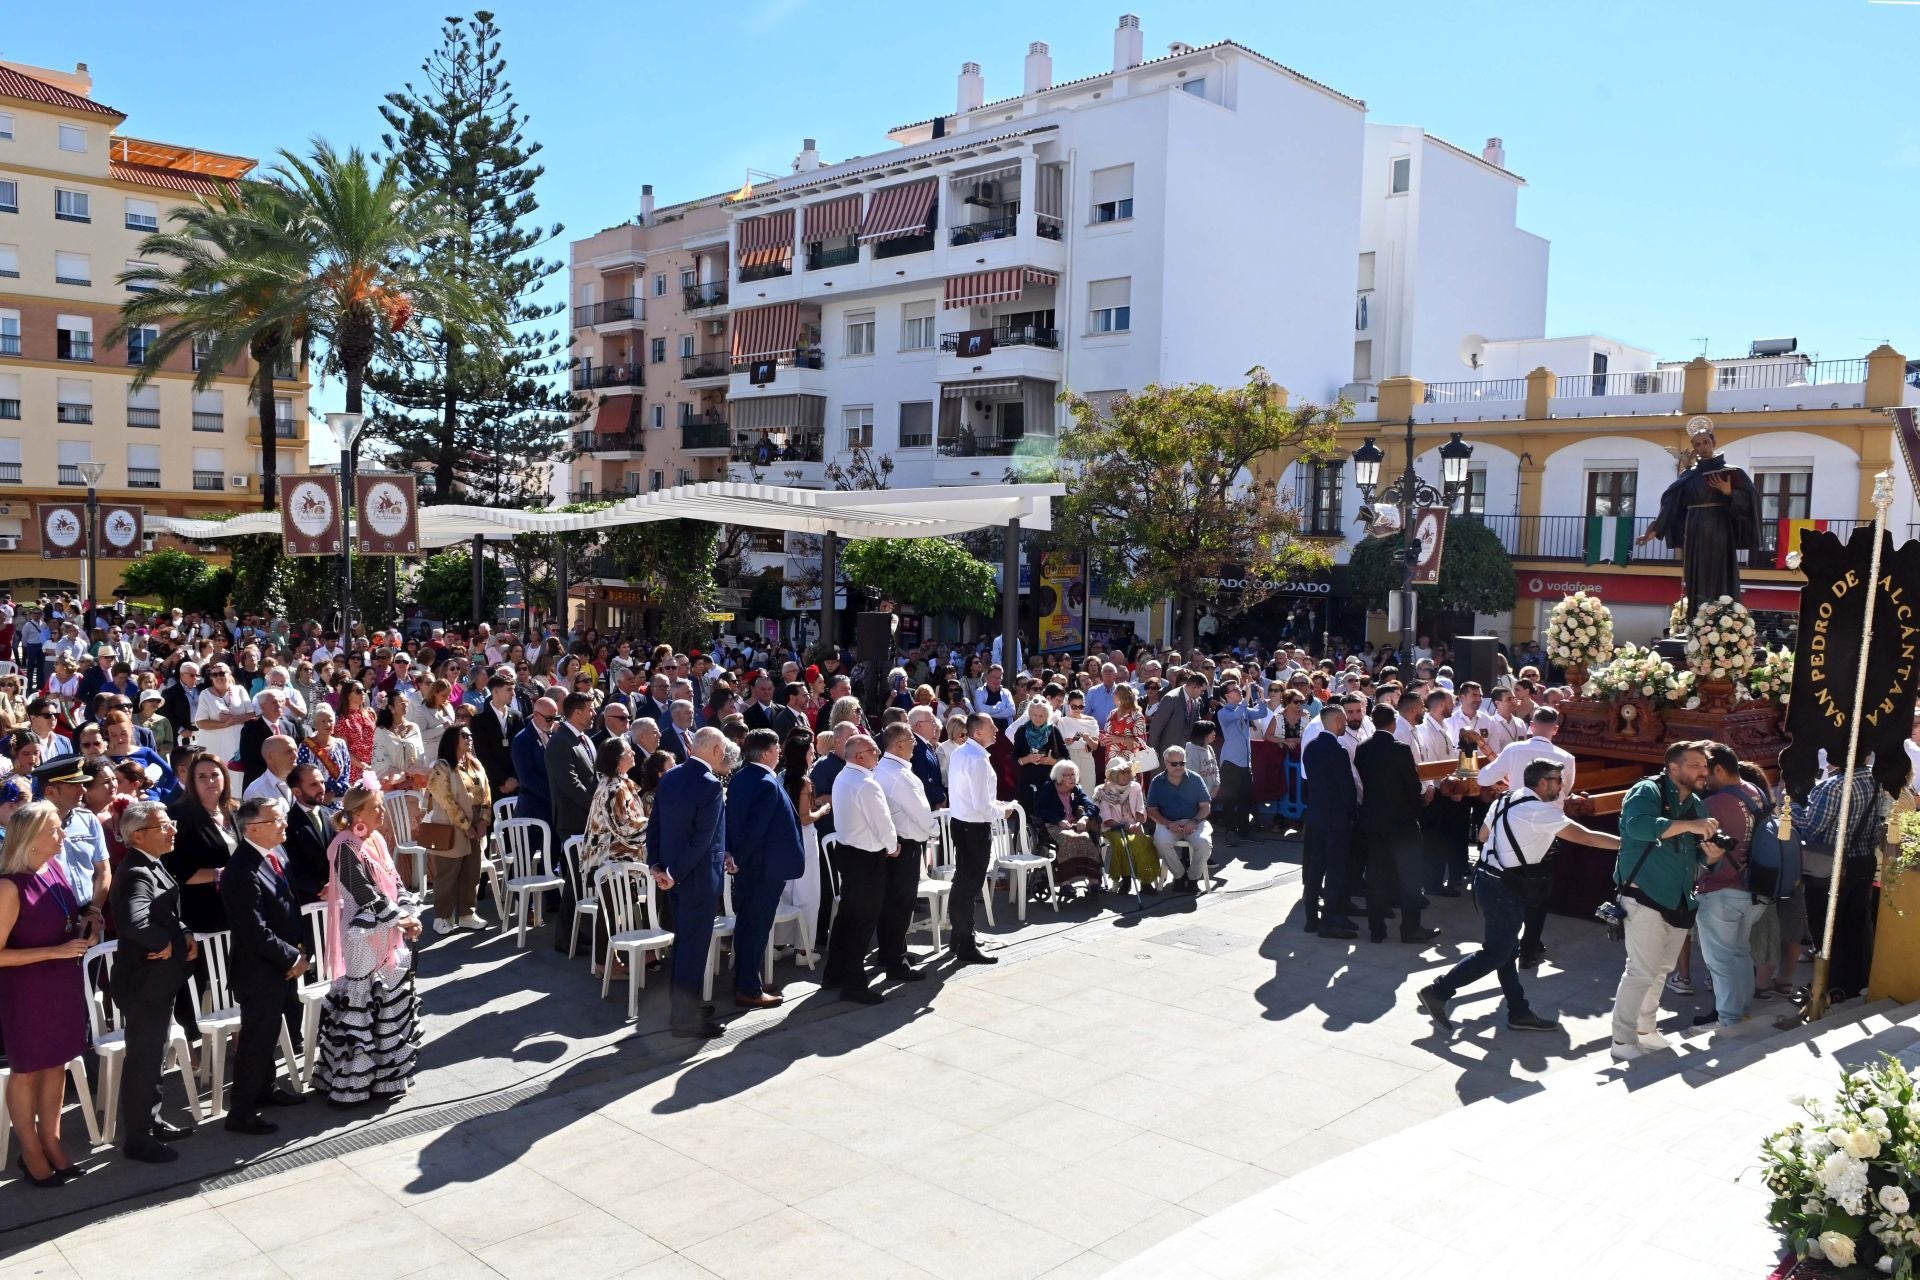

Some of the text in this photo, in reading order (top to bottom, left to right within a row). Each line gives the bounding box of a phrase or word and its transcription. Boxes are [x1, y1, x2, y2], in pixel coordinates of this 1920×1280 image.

[1199, 577, 1249, 589] PRADO
[1547, 582, 1602, 592] vodafone
[1831, 569, 1860, 599] DE
[1810, 602, 1833, 682] PEDRO
[1814, 687, 1846, 728] SAN
